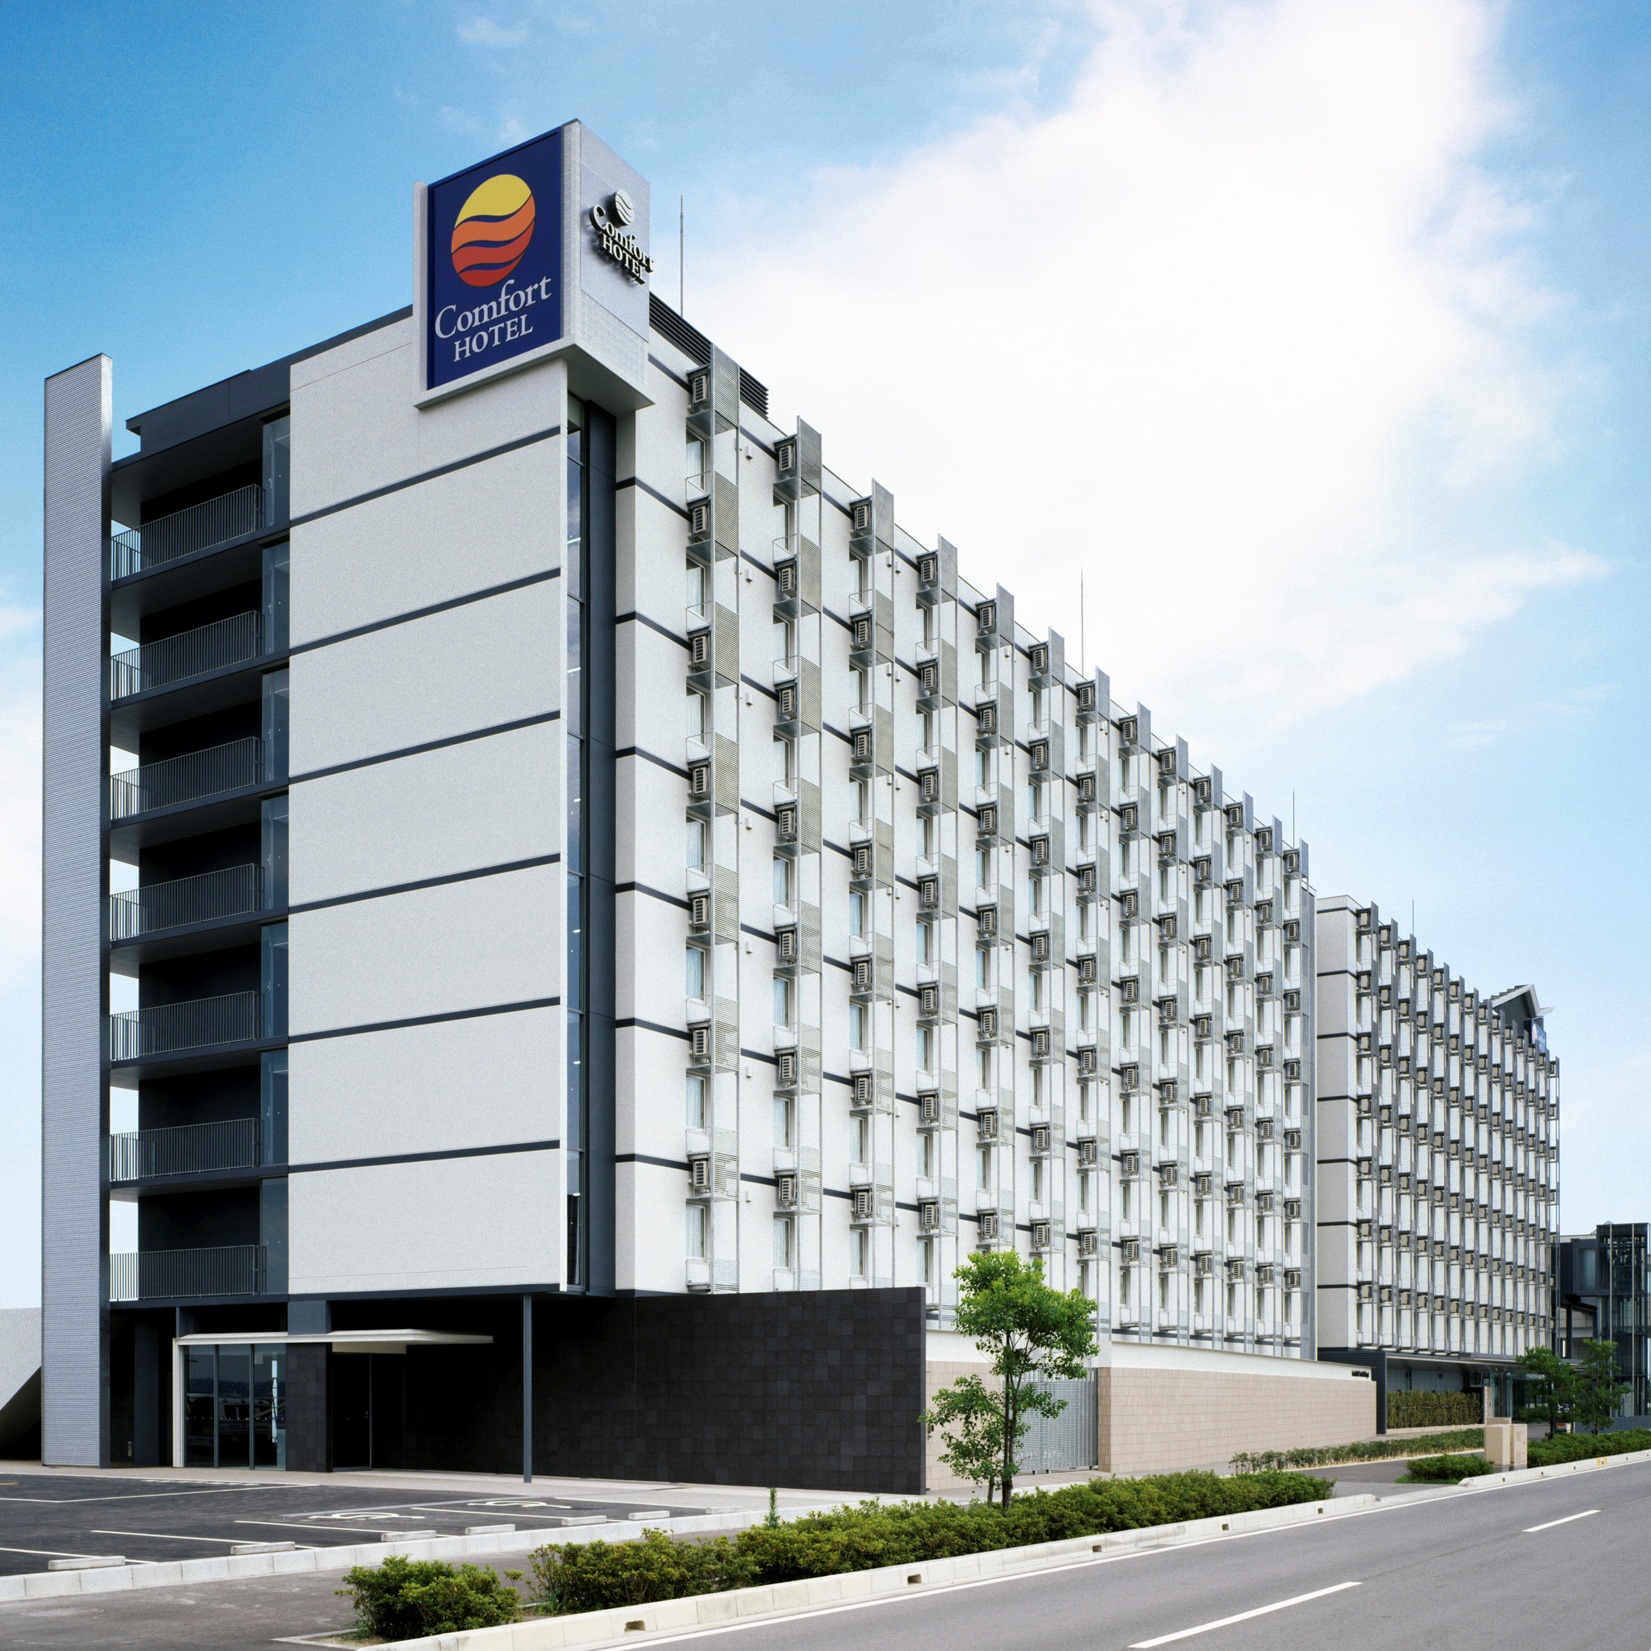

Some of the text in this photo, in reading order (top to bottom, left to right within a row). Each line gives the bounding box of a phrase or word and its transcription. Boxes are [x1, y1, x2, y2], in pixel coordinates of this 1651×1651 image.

[591, 205, 654, 273] Comfort
[602, 233, 645, 284] HOTEL
[435, 275, 552, 339] Comfort
[453, 313, 534, 362] HOTEL
